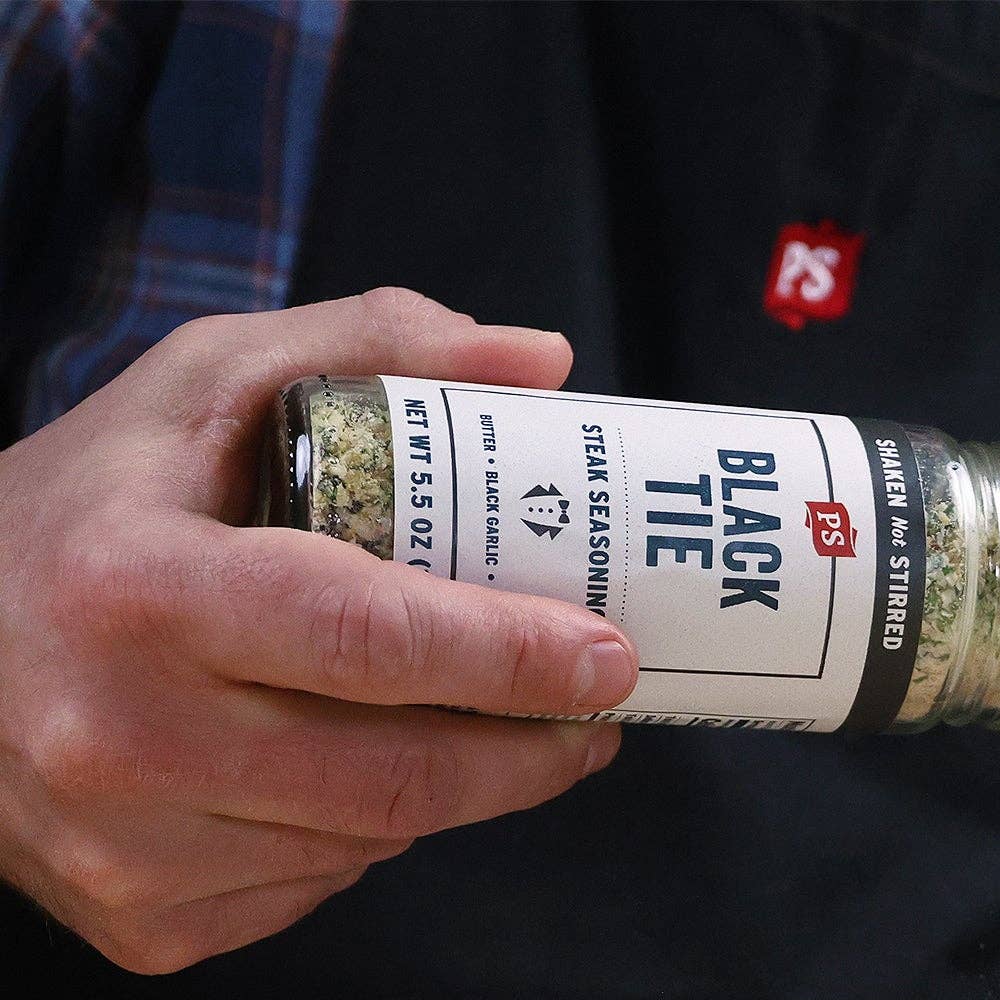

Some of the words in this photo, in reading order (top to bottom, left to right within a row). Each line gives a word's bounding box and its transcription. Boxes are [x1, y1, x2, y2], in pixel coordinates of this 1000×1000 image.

[775, 240, 841, 301] PS
[404, 399, 429, 431] NET
[480, 414, 496, 451] BUTTER
[409, 435, 431, 464] WT
[581, 424, 608, 483] STEAK
[410, 472, 432, 508] 5.5
[485, 471, 499, 512] BLACK
[875, 438, 907, 507] SHAKEN
[410, 518, 432, 549] OZ
[484, 516, 499, 566] GARLIC
[645, 474, 713, 569] TIE
[717, 448, 782, 611] BLACK
[817, 511, 845, 548] PS
[891, 516, 909, 548] Not
[585, 490, 610, 617] SEASONIN
[882, 555, 910, 651] STIRRED
